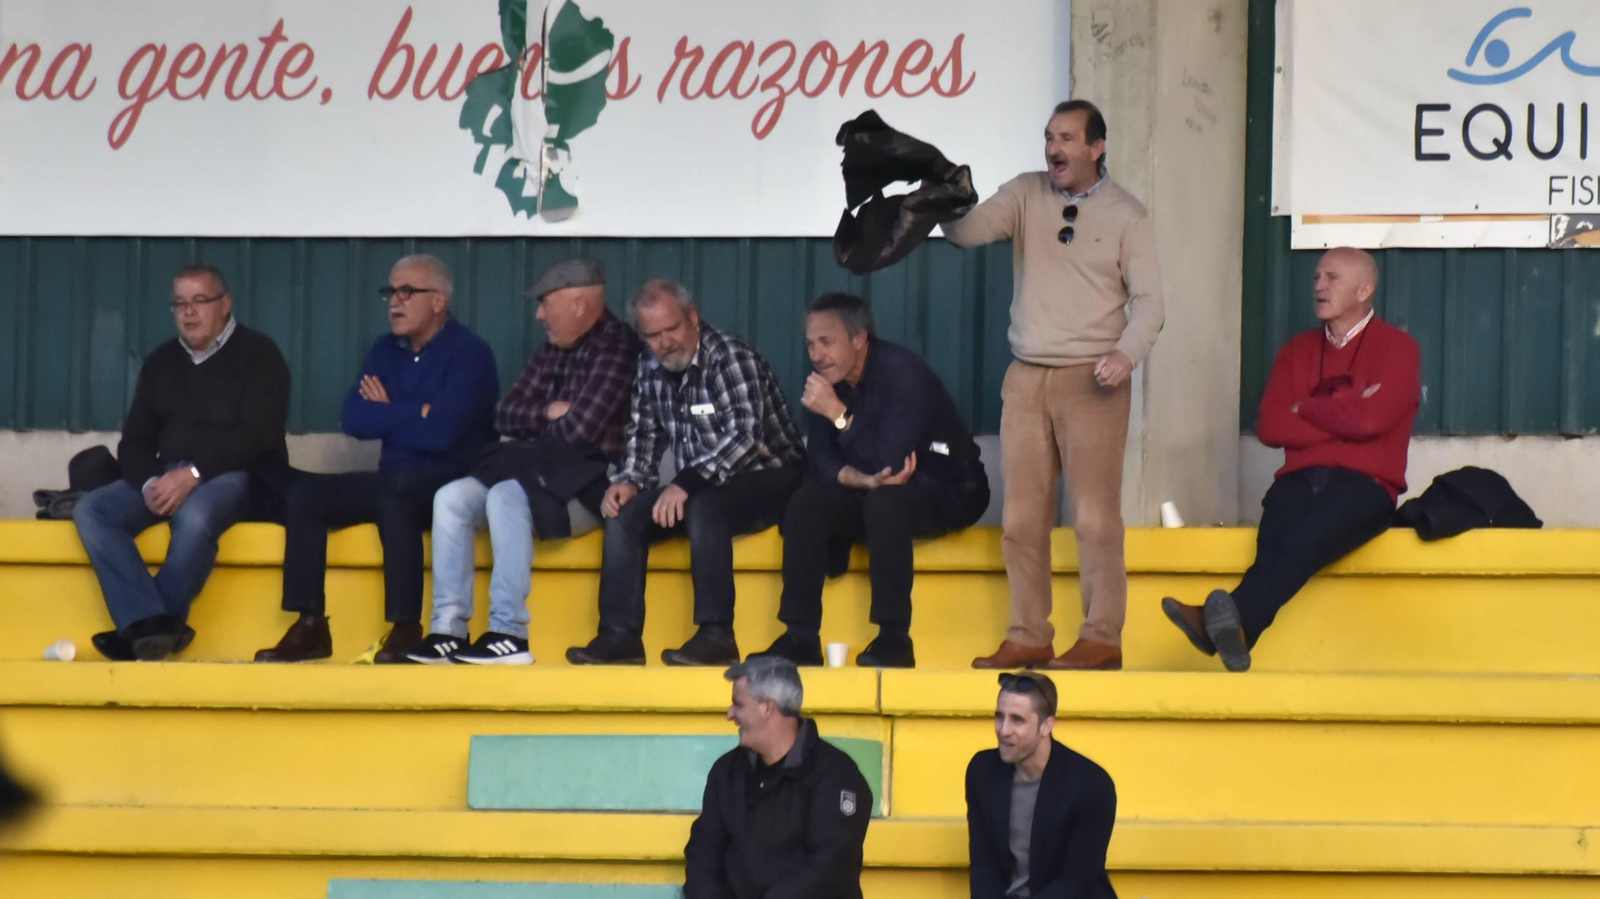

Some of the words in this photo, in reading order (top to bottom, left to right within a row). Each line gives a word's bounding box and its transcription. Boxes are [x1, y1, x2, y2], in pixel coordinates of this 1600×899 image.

[107, 18, 333, 150] gente,
[368, 6, 642, 101] buens
[657, 33, 976, 140] razones
[1548, 175, 1600, 206] FIS
